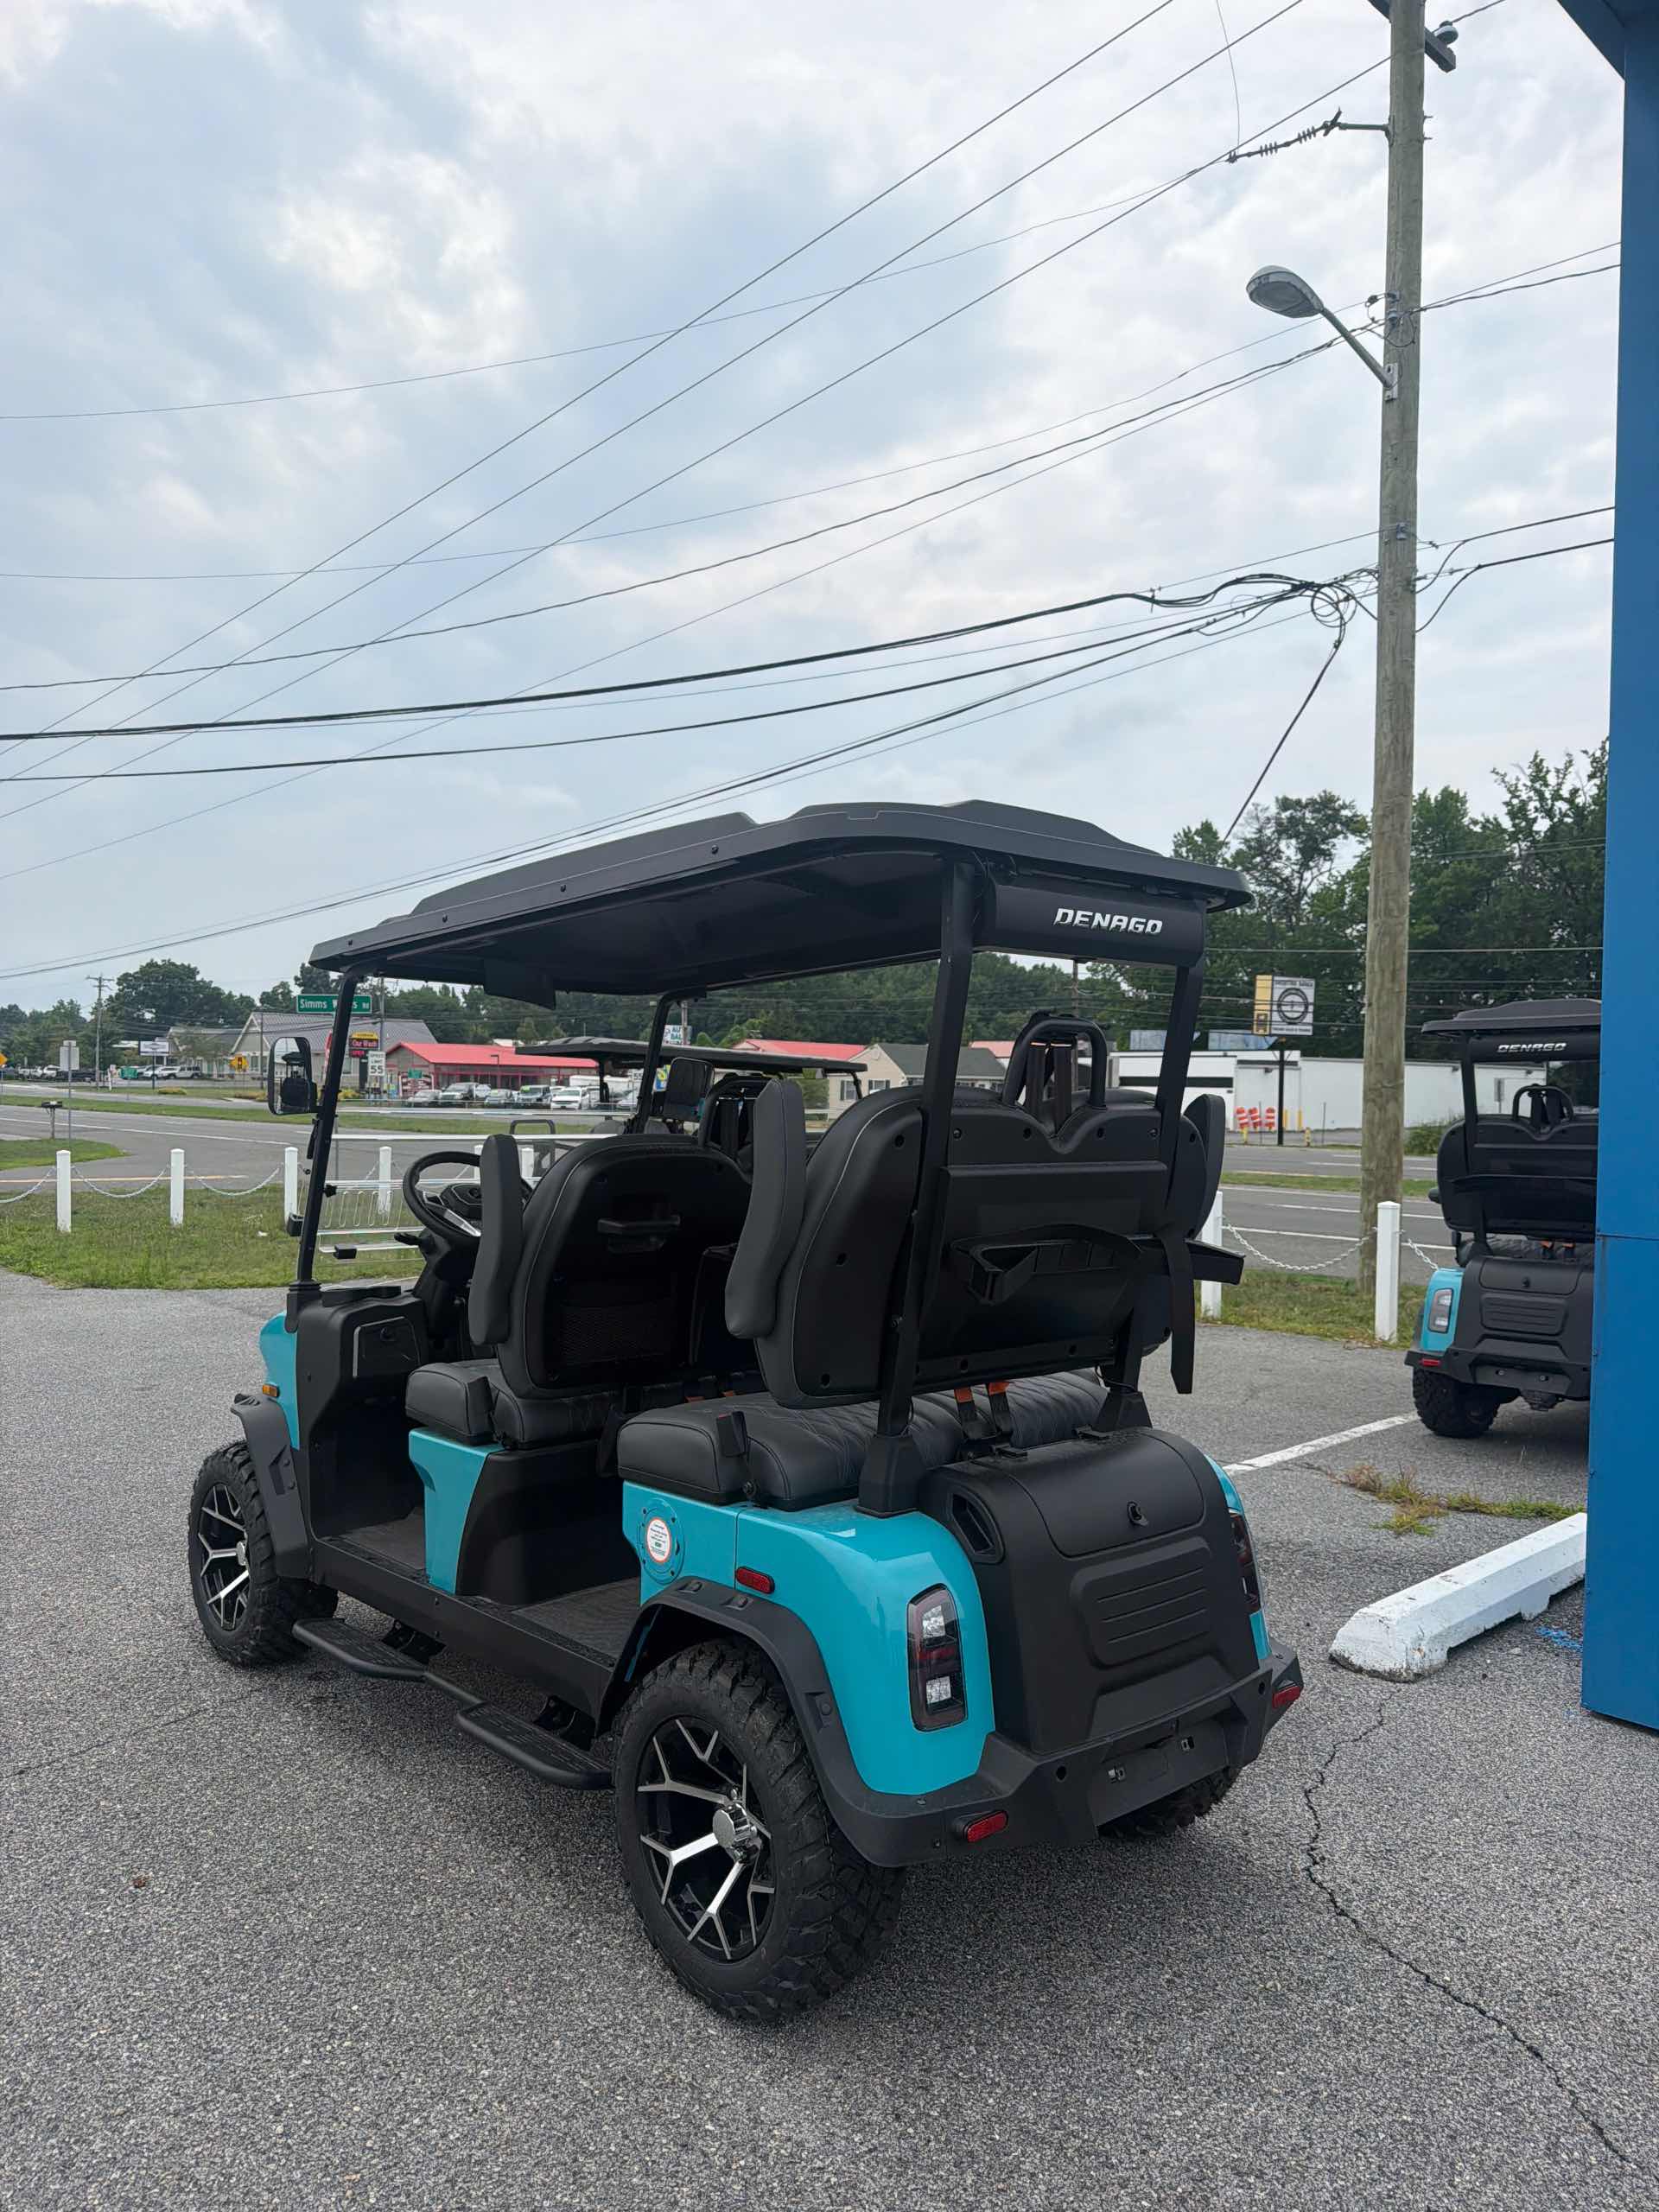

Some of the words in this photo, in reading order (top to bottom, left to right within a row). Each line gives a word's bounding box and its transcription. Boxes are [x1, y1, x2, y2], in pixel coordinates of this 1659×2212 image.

[1053, 907, 1163, 934] DENAGO
[299, 999, 327, 1009] Simms
[1497, 1042, 1567, 1053] DENAGO
[370, 1065, 384, 1074] 55
